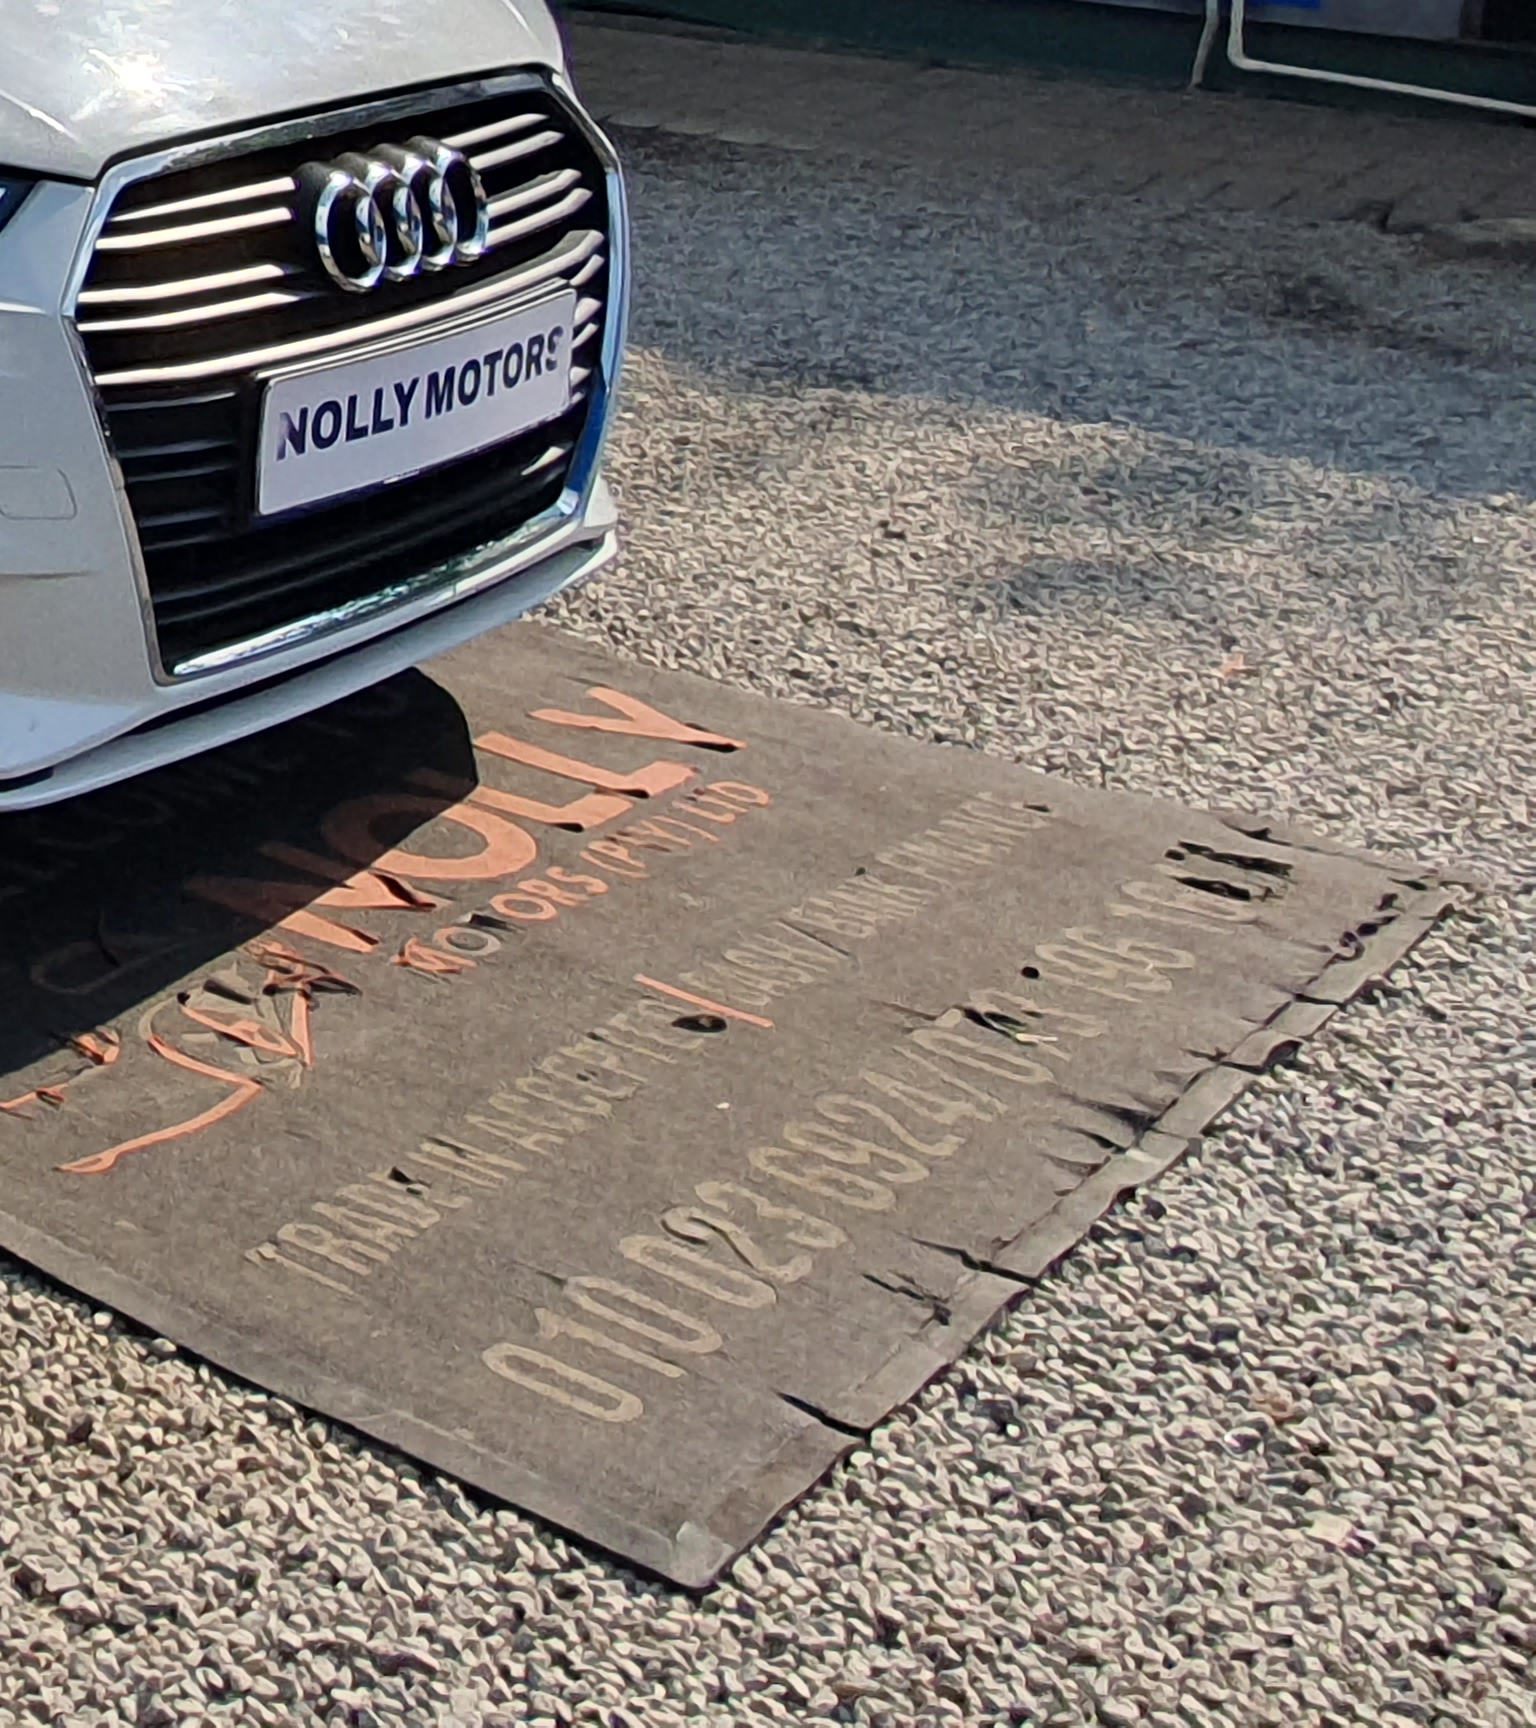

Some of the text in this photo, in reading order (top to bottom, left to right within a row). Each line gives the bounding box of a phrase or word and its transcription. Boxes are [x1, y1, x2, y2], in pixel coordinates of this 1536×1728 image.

[277, 325, 564, 461] NOLLY MOTORS
[185, 685, 748, 954] NOLLY
[481, 1275, 722, 1423] 010
[619, 1181, 848, 1310] 023
